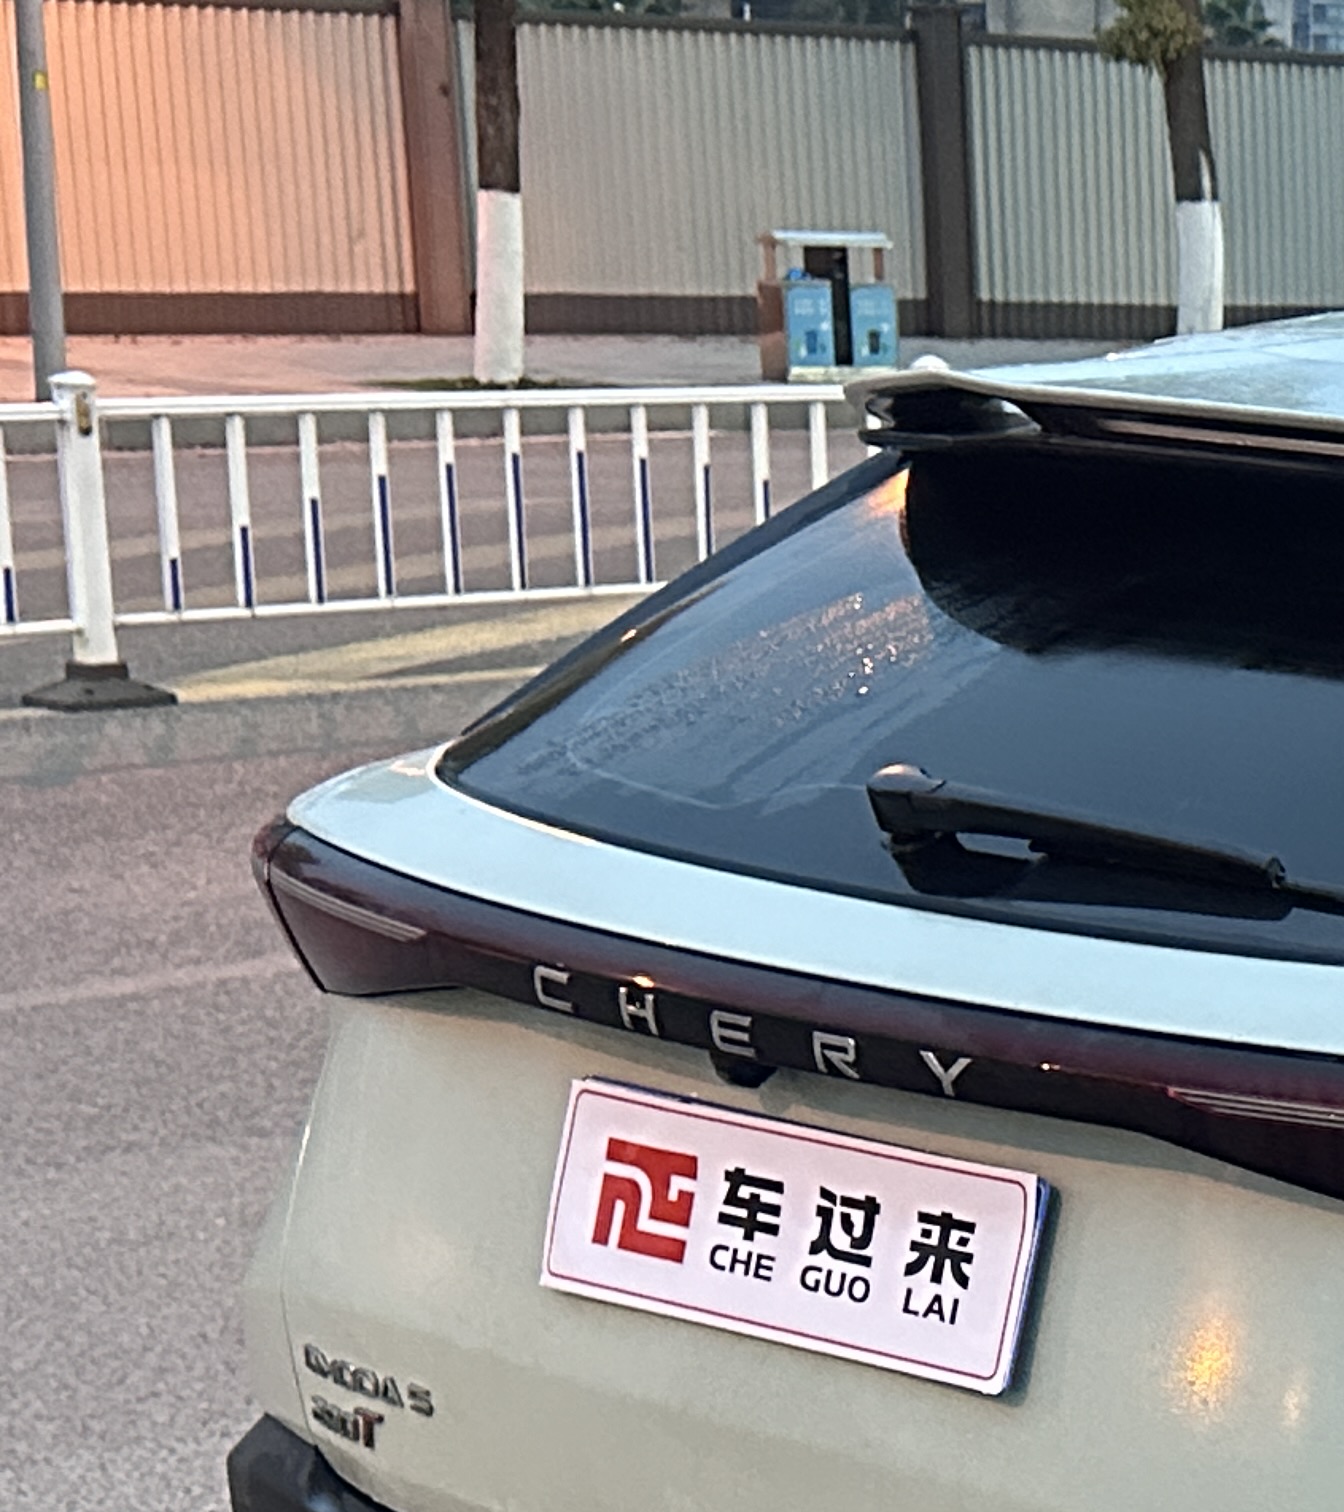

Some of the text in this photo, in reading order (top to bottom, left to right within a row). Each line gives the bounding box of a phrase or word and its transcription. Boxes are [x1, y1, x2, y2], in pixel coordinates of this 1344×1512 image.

[533, 964, 972, 1097] CHERY
[709, 1244, 960, 1325] CHE GUO LAI
[717, 1166, 977, 1291] 车过来
